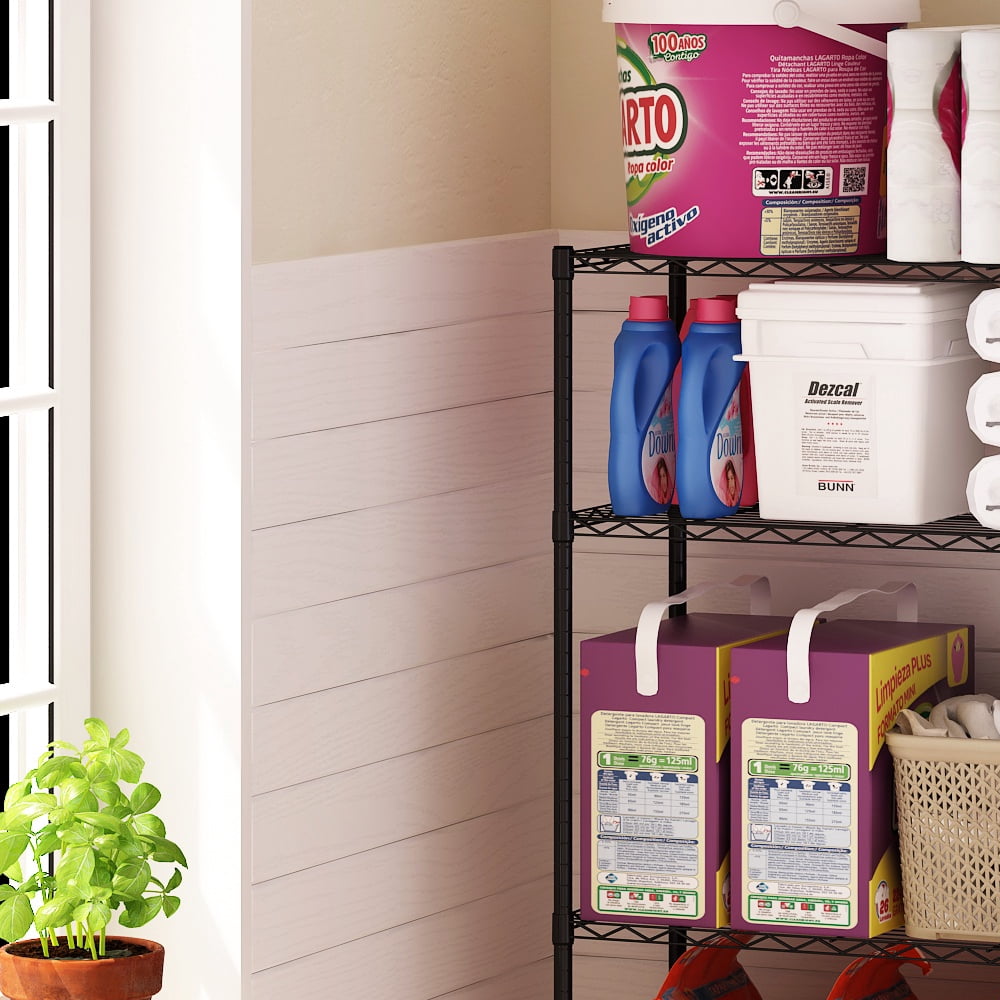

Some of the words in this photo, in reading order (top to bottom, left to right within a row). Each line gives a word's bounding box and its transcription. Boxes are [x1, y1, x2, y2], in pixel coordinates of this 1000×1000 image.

[651, 33, 679, 53] 100
[664, 51, 700, 62] Contigo
[770, 54, 813, 62] Quitamanchas
[645, 156, 674, 173] color
[647, 206, 699, 246] activo
[807, 380, 860, 397] Dezcal
[817, 482, 854, 492] BUNN
[875, 663, 911, 713] Limpieza
[911, 653, 932, 675] PLUS
[602, 753, 611, 765] 1
[641, 755, 658, 765] 76g
[666, 756, 693, 765] 125ml
[753, 761, 762, 773] 1
[792, 763, 809, 773] 76g
[818, 764, 845, 774] 125ml
[879, 897, 889, 915] 26
